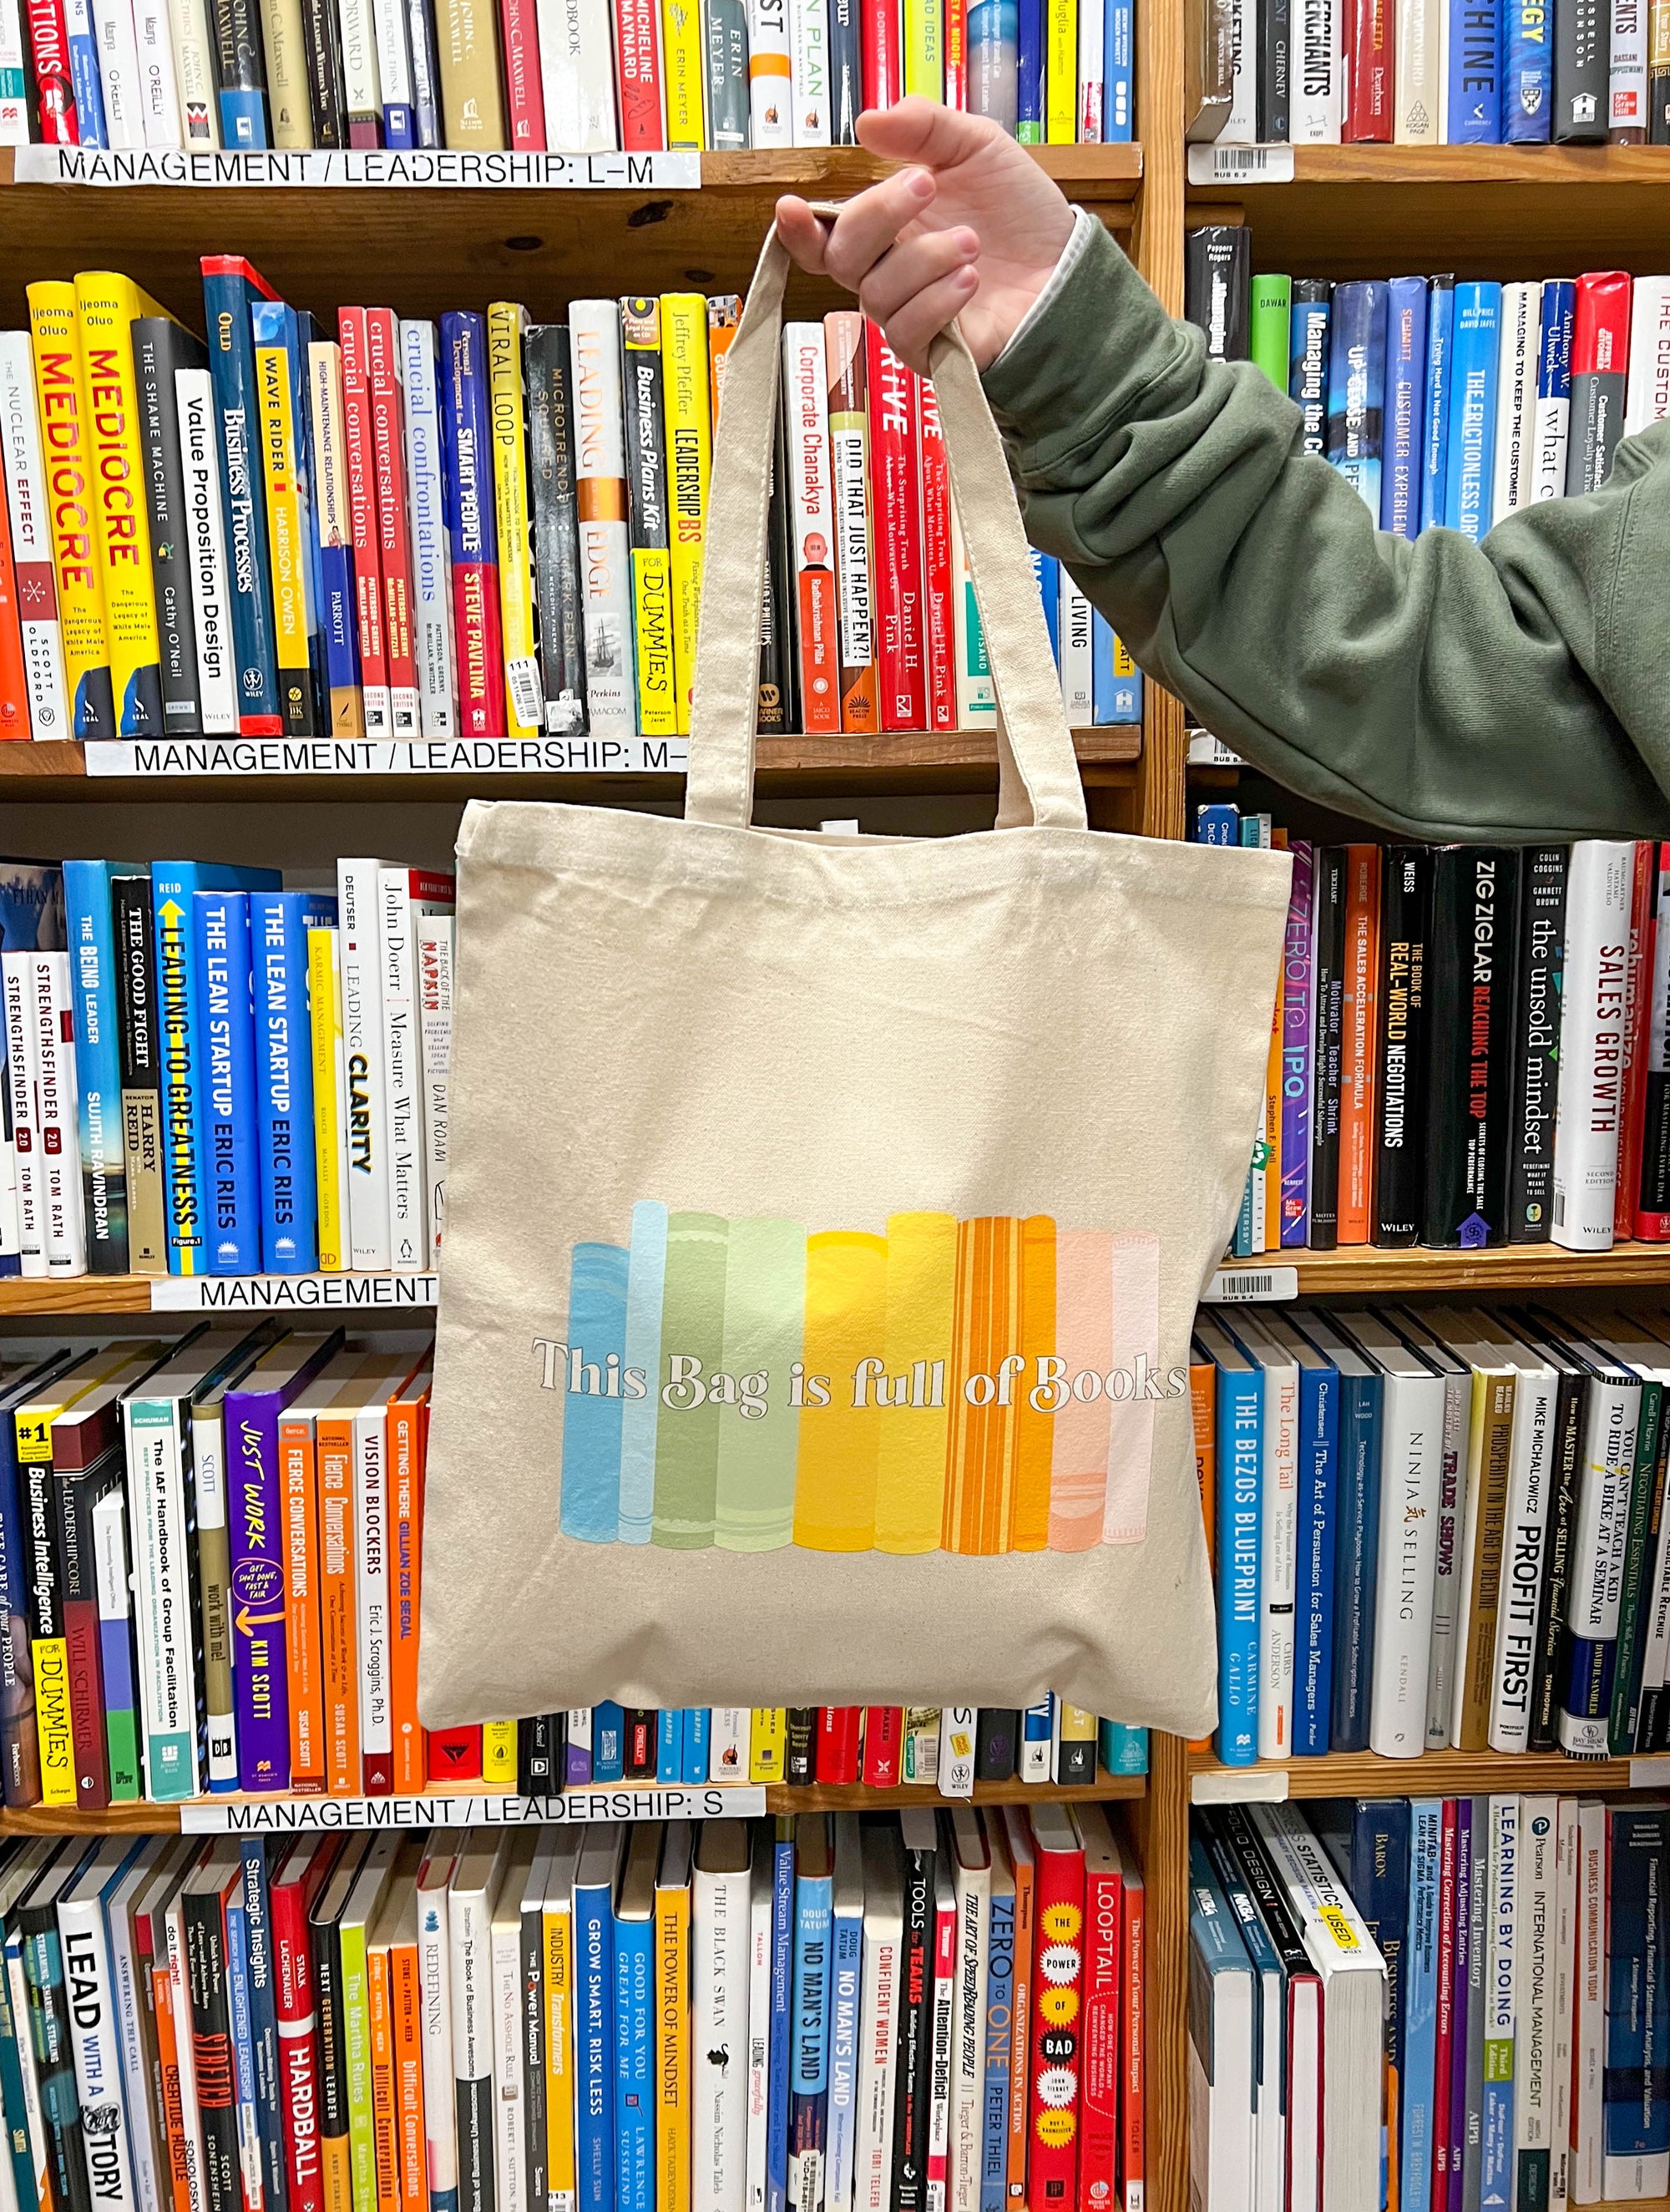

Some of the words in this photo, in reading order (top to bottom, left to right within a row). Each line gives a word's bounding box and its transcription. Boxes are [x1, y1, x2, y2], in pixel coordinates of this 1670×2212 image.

[620, 0, 638, 78] MAYNARD
[636, 0, 654, 84] MICHELINE
[676, 48, 686, 81] ERIN
[510, 43, 525, 109] MAXWELL
[1276, 40, 1287, 98] CHERNEV
[1374, 68, 1384, 116] Dearborn
[677, 84, 687, 127] MEYER
[59, 151, 312, 184] MANAGEMENT
[323, 154, 331, 181] /
[343, 152, 574, 184] LEADERSHIP:
[1260, 299, 1287, 309] DAWAR
[1518, 291, 1527, 356] MANAGING
[142, 342, 154, 372] THE
[266, 357, 280, 409] WAVE
[407, 330, 432, 418] crucial
[1516, 361, 1525, 377] TO
[145, 382, 160, 438] SHAME
[799, 346, 818, 428] Corporate
[1515, 380, 1523, 412] KEEP
[8, 386, 28, 473] NUCLEAR
[185, 397, 205, 461] Value
[222, 407, 246, 494] Business
[269, 417, 286, 472] RIDER
[456, 428, 474, 488] SMART
[845, 439, 863, 471] DID
[40, 353, 95, 592] MEDIOCRE
[151, 446, 168, 523] MACHINE
[802, 434, 821, 516] Chanakya
[846, 476, 864, 518] THAT
[1509, 443, 1521, 507] CUSTOMER
[17, 478, 34, 546] EFFECT
[192, 468, 217, 597] Proposition
[412, 427, 436, 602] confrontations
[460, 490, 480, 551] PEOPLE
[230, 500, 254, 594] Processes
[274, 506, 292, 583] HARRISON
[849, 524, 866, 569] JUST
[164, 587, 179, 628] Cathy
[281, 587, 296, 635] OWEN
[643, 573, 668, 691] DUMMIES
[850, 575, 870, 660] HAPPEN?!
[166, 635, 182, 678] O'Neil
[202, 603, 221, 680] Design
[590, 690, 620, 699] Perkins
[134, 742, 377, 772] MANAGEMENT
[388, 742, 397, 770] /
[408, 741, 630, 769] LEADERSHIP:
[384, 883, 400, 922] John
[1476, 861, 1495, 900] ZIG
[79, 914, 93, 942] THE
[205, 905, 225, 950] THE
[1474, 904, 1495, 982] ZIGLAR
[1532, 919, 1556, 959] the
[80, 945, 95, 989] BEING
[207, 956, 227, 1015] LEAN
[387, 929, 400, 990] Doerr
[1597, 945, 1624, 1022] SALES
[85, 995, 99, 1045] LEADER
[1389, 942, 1408, 1040] REAL-WORLD
[1470, 985, 1490, 1056] REACHING
[1528, 968, 1552, 1047] unsold
[36, 964, 58, 1119] STRENGTHSFINDER
[210, 1021, 233, 1116] STARTUP
[391, 1011, 404, 1089] Measure
[1384, 1044, 1406, 1148] NEGOTIATIONS
[1469, 1060, 1487, 1094] THE
[1523, 1056, 1548, 1155] mindset
[1591, 1031, 1618, 1132] GROWTH
[86, 1091, 103, 1145] SUJITH
[347, 1051, 372, 1175] CLARITY
[392, 1096, 411, 1144] What
[1469, 1096, 1485, 1118] TOP
[215, 1124, 235, 1174] ERIC
[90, 1150, 109, 1240] RAVINDRAN
[217, 1177, 236, 1230] RIES
[396, 1148, 410, 1219] Matters
[201, 1278, 437, 1306] MANAGEMENT
[531, 1336, 647, 1400] This
[661, 1353, 770, 1419] Bag
[787, 1361, 831, 1408] is
[851, 1356, 944, 1408] full
[964, 1354, 1026, 1407] of
[1029, 1353, 1187, 1412] Books
[1281, 1382, 1295, 1413] The
[1235, 1392, 1257, 1430] THE
[1275, 1418, 1291, 1458] Long
[1534, 1397, 1547, 1426] MIKE
[154, 1438, 163, 1466] The
[240, 1421, 265, 1486] JUST
[287, 1449, 302, 1496] FIERCE
[364, 1436, 379, 1489] VISION
[1234, 1439, 1257, 1503] BEZOS
[1279, 1460, 1294, 1491] Tail
[1404, 1432, 1423, 1501] NINJA
[1528, 1430, 1545, 1514] MICHALOWICZ
[28, 1466, 48, 1538] Business
[156, 1471, 165, 1494] IAF
[157, 1498, 169, 1573] Handbook
[245, 1485, 266, 1549] WORK
[366, 1496, 381, 1575] BLOCKERS
[288, 1500, 307, 1597] CONVERSATIONS
[1233, 1510, 1257, 1622] BLUEPRINT
[1399, 1529, 1418, 1620] SELLING
[1511, 1524, 1541, 1626] PROFIT
[33, 1540, 54, 1634] Intelligence
[162, 1579, 172, 1593] of
[163, 1598, 173, 1643] Group
[250, 1640, 267, 1669] KIM
[1503, 1634, 1537, 1712] FIRST
[40, 1658, 68, 1769] DUMMIES
[166, 1648, 176, 1729] Facilitation
[251, 1673, 271, 1719] SCOTT
[905, 1740, 916, 1775] Goodwill
[227, 1799, 455, 1829] MANAGEMENT
[465, 1799, 473, 1822] /
[483, 1792, 692, 1821] LEADERSHIP:
[703, 1791, 724, 1815] S
[1500, 1806, 1516, 1914] LEARNING
[1535, 1838, 1546, 1880] Pearson
[245, 1859, 260, 1929] Strategic
[714, 1884, 726, 1917] THE
[1055, 1919, 1070, 1927] THE
[589, 1920, 600, 1969] GROW
[714, 1927, 726, 1977] BLACK
[992, 1903, 1013, 1978] ZERO
[1096, 1882, 1114, 1989] LOOPTAIL
[1326, 1914, 1351, 1942] USED
[1500, 1920, 1516, 1949] BY
[1532, 1891, 1546, 2006] INTERNATIONAL
[66, 1933, 100, 2029] LEAD
[248, 1930, 266, 1988] Insights
[1047, 1959, 1076, 1969] POWER
[589, 1977, 601, 2032] SMART,
[714, 1985, 726, 2027] SWAN
[997, 1983, 1005, 1999] TO
[1055, 2001, 1065, 2010] OF
[1498, 1957, 1511, 2026] DOING
[589, 2037, 601, 2074] RISK
[986, 2005, 1010, 2068] ONE
[1046, 2039, 1072, 2055] BAD
[1527, 2010, 1541, 2108] MANAGEMENT
[289, 2047, 314, 2185] HARDBALL
[590, 2078, 603, 2115] LESS
